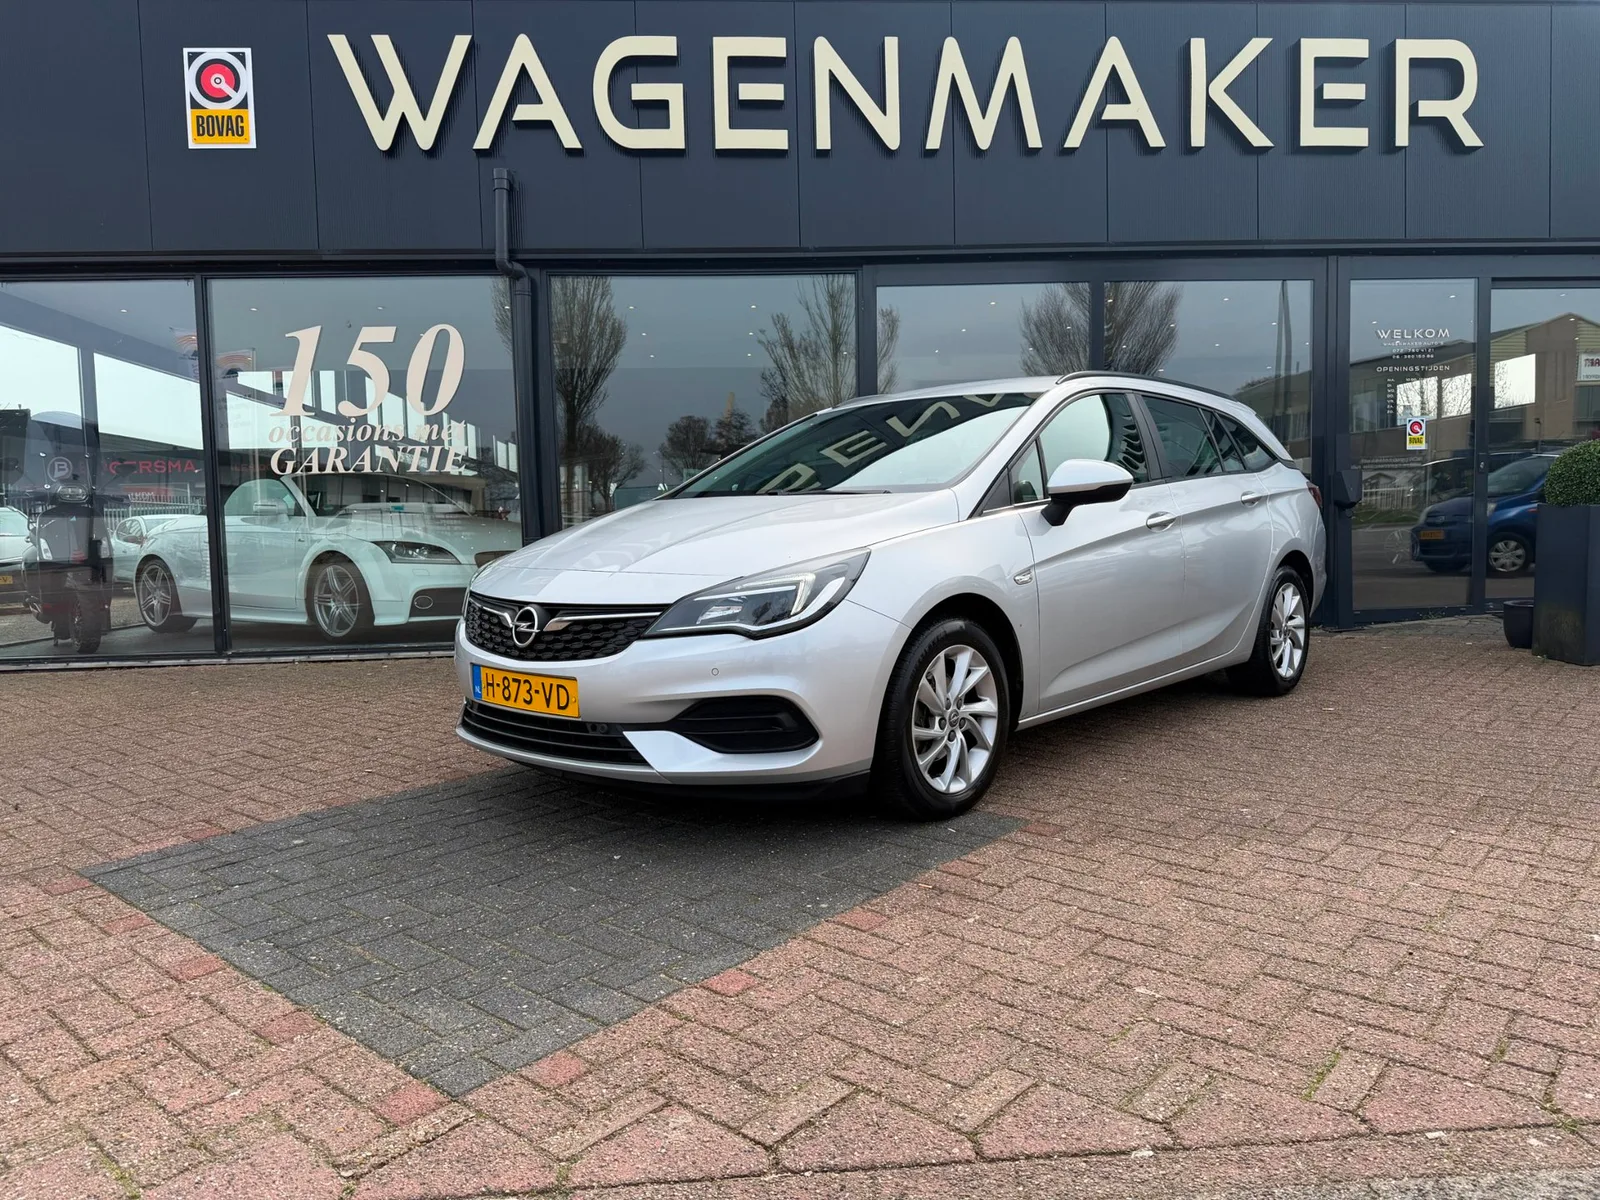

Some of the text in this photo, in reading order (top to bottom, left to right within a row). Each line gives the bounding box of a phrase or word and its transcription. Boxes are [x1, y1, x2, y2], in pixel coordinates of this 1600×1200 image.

[327, 33, 1484, 151] WAGENMAKER
[195, 114, 245, 137] BOVAG
[1376, 328, 1450, 339] WELKOM
[269, 323, 465, 417] 150
[1376, 365, 1451, 373] OPENINGSTIJDEN
[268, 417, 467, 443] occasions met
[270, 445, 470, 476] GARANTIE
[484, 672, 570, 710] H-873-VD
